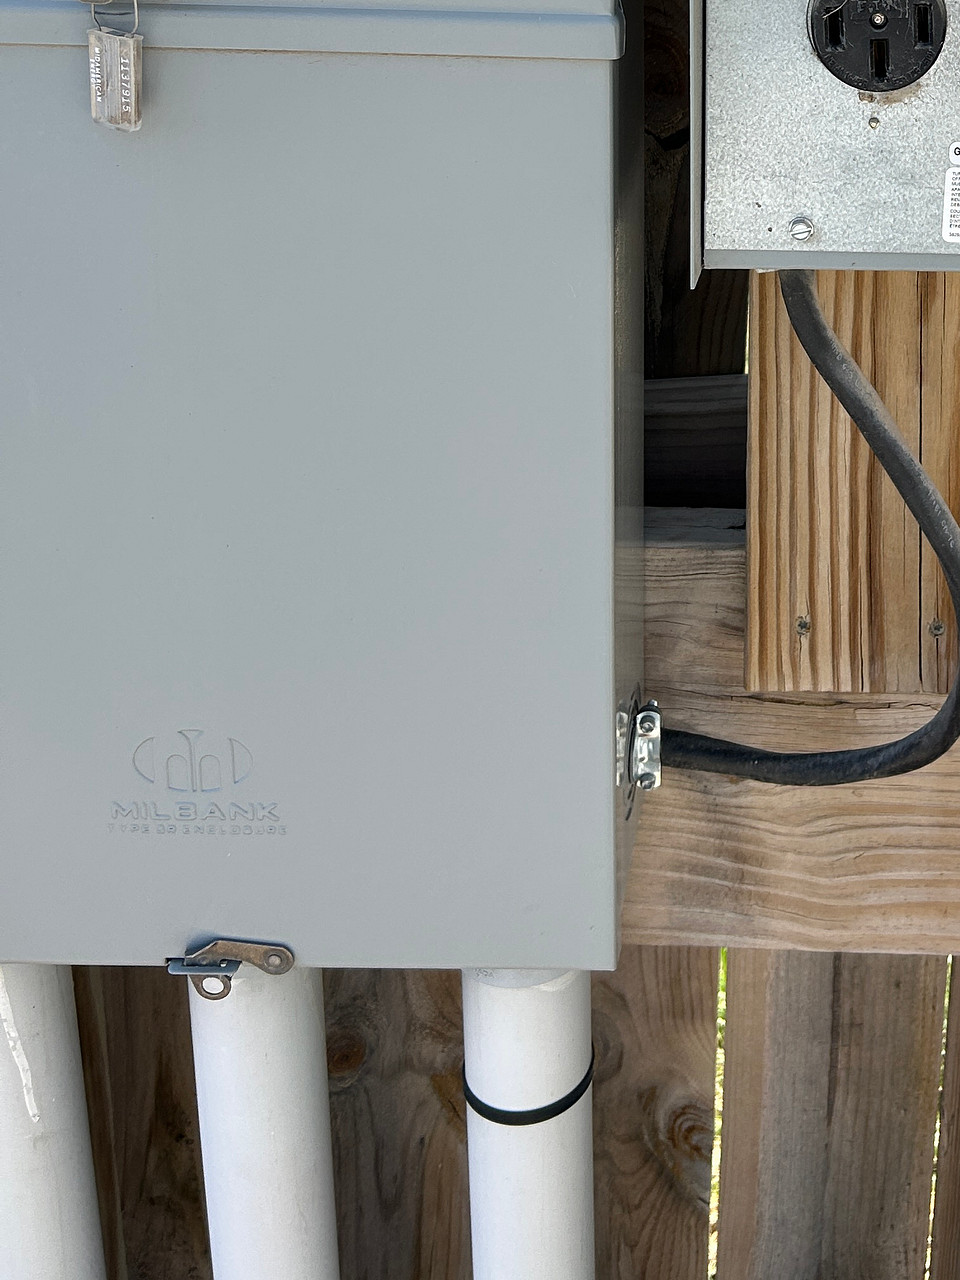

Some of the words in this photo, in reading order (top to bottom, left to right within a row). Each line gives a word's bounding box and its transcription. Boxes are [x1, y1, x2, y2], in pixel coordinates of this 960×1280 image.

[94, 47, 102, 102] MIDAMERICAN
[121, 57, 131, 113] 1137915
[110, 800, 280, 821] MILBANK
[107, 824, 150, 834] TYPE
[182, 824, 287, 836] ENCLOSURE
